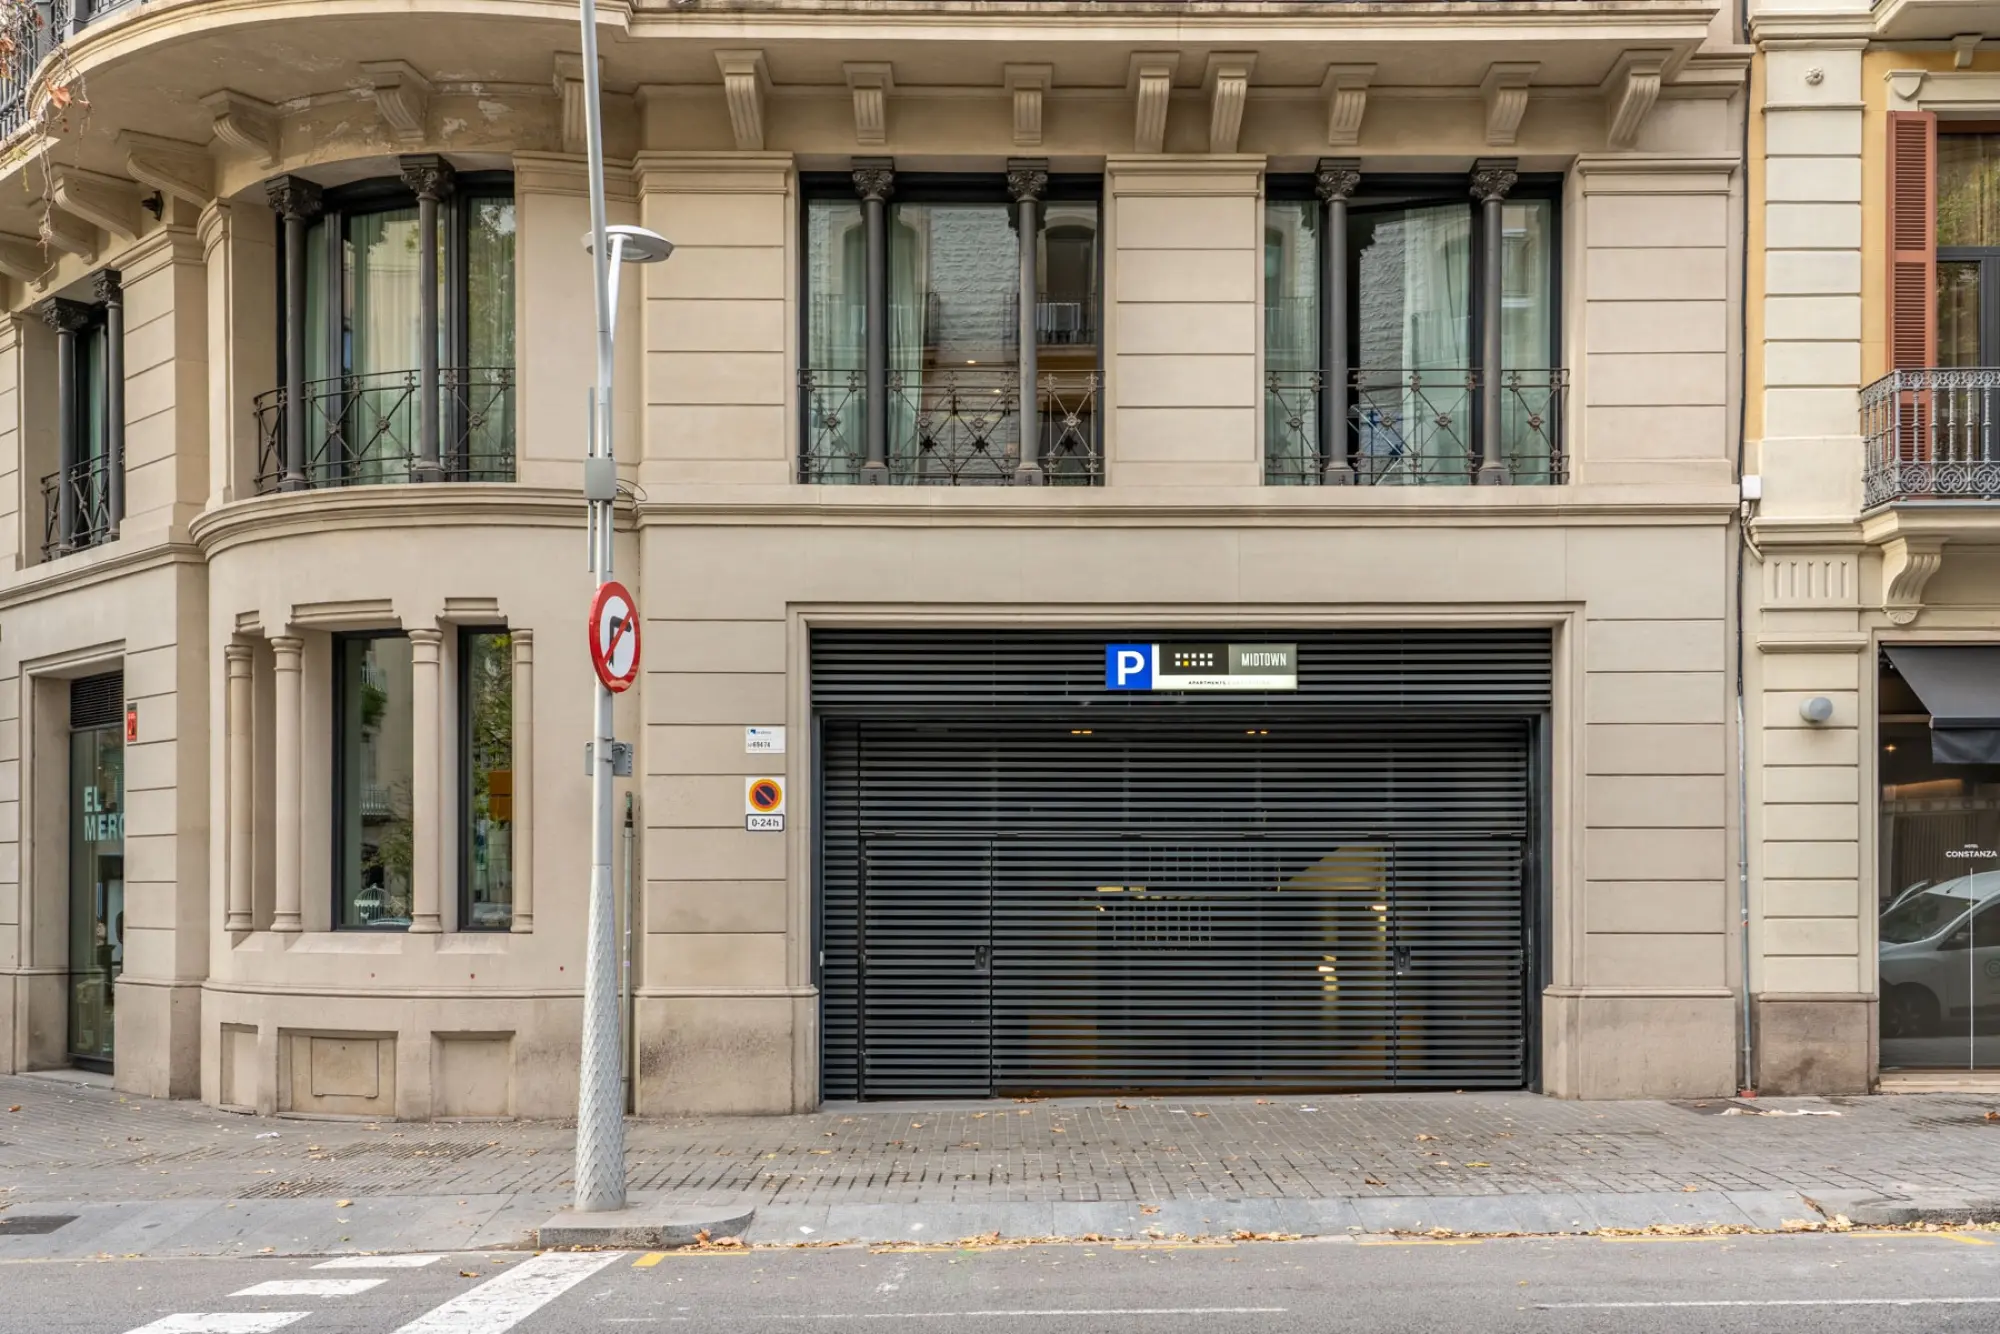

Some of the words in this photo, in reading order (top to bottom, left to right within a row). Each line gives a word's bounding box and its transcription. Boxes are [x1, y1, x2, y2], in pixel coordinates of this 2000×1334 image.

[1117, 651, 1145, 685] P
[1241, 652, 1287, 667] MIDTOWN
[84, 787, 102, 812] EL
[1945, 850, 1997, 858] CONSTANZA
